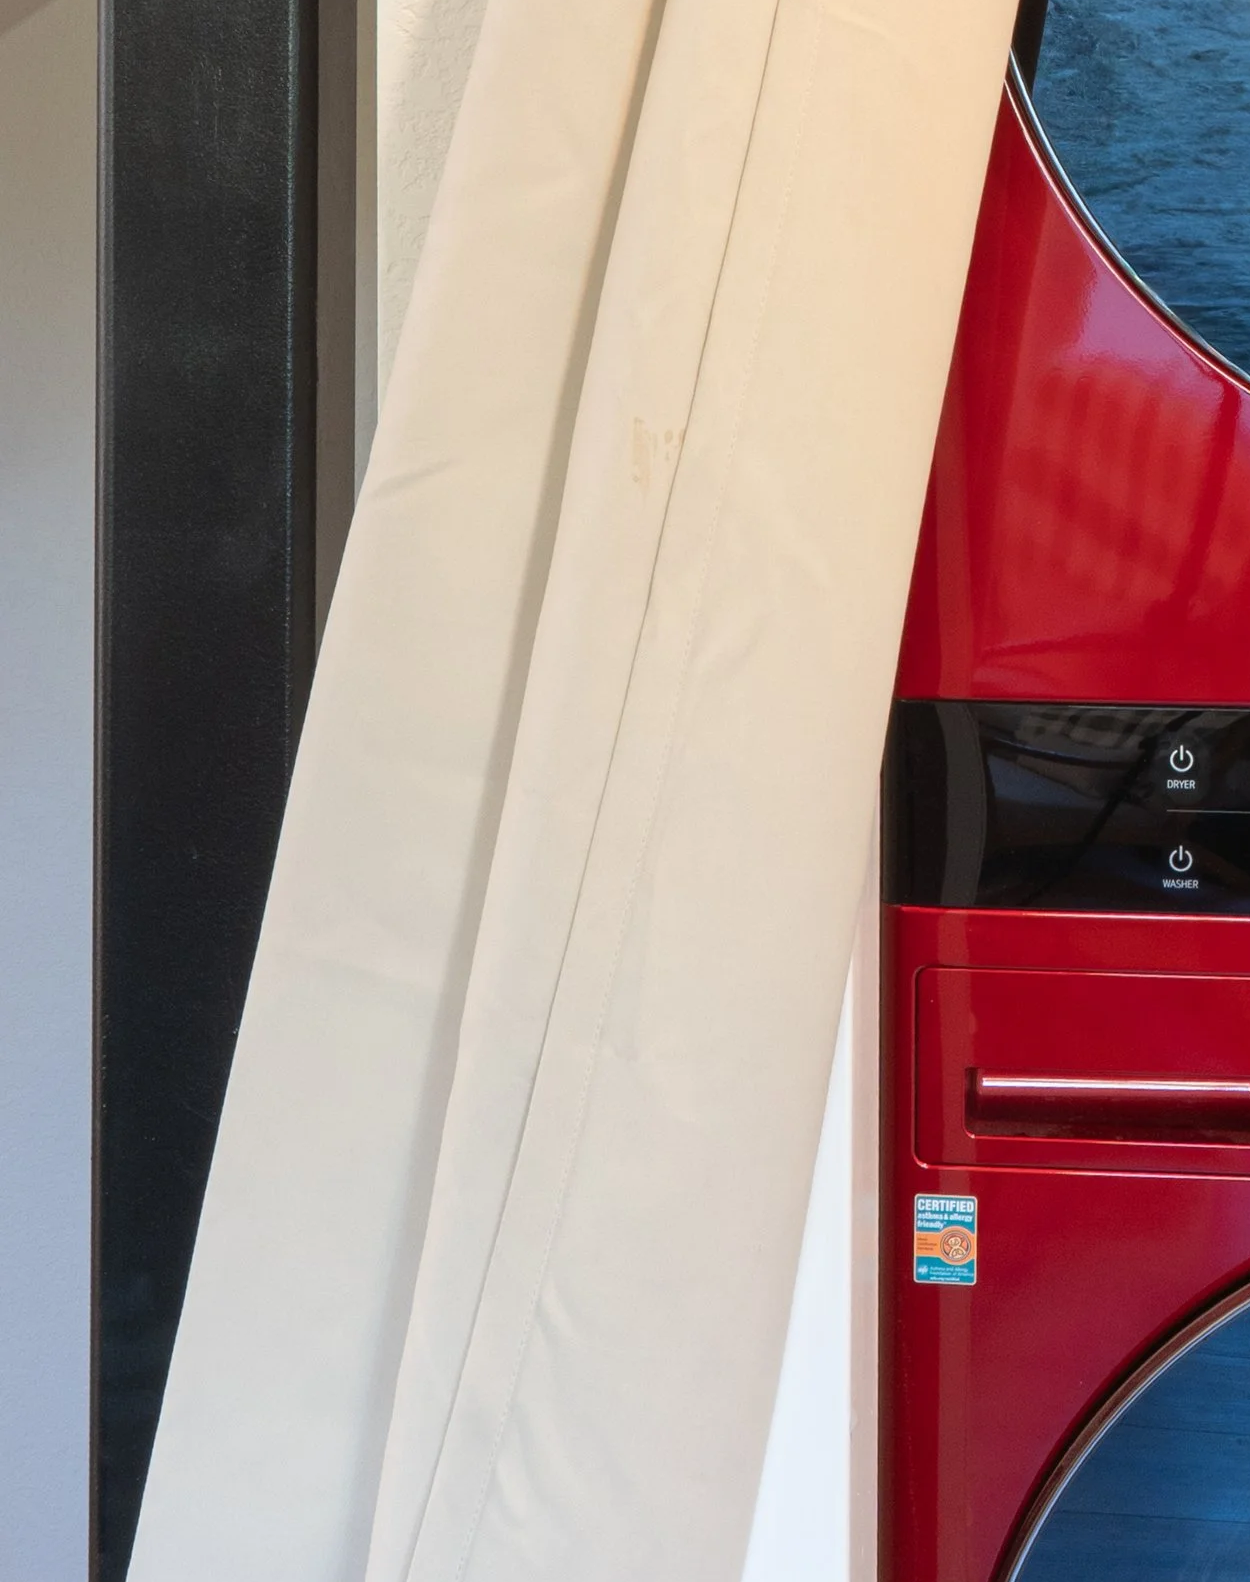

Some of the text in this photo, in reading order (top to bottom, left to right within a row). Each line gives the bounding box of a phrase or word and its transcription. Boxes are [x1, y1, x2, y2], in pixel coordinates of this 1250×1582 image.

[1167, 779, 1196, 790] DRYER
[1162, 879, 1199, 889] WASHER
[917, 1198, 974, 1212] CERTIFIED
